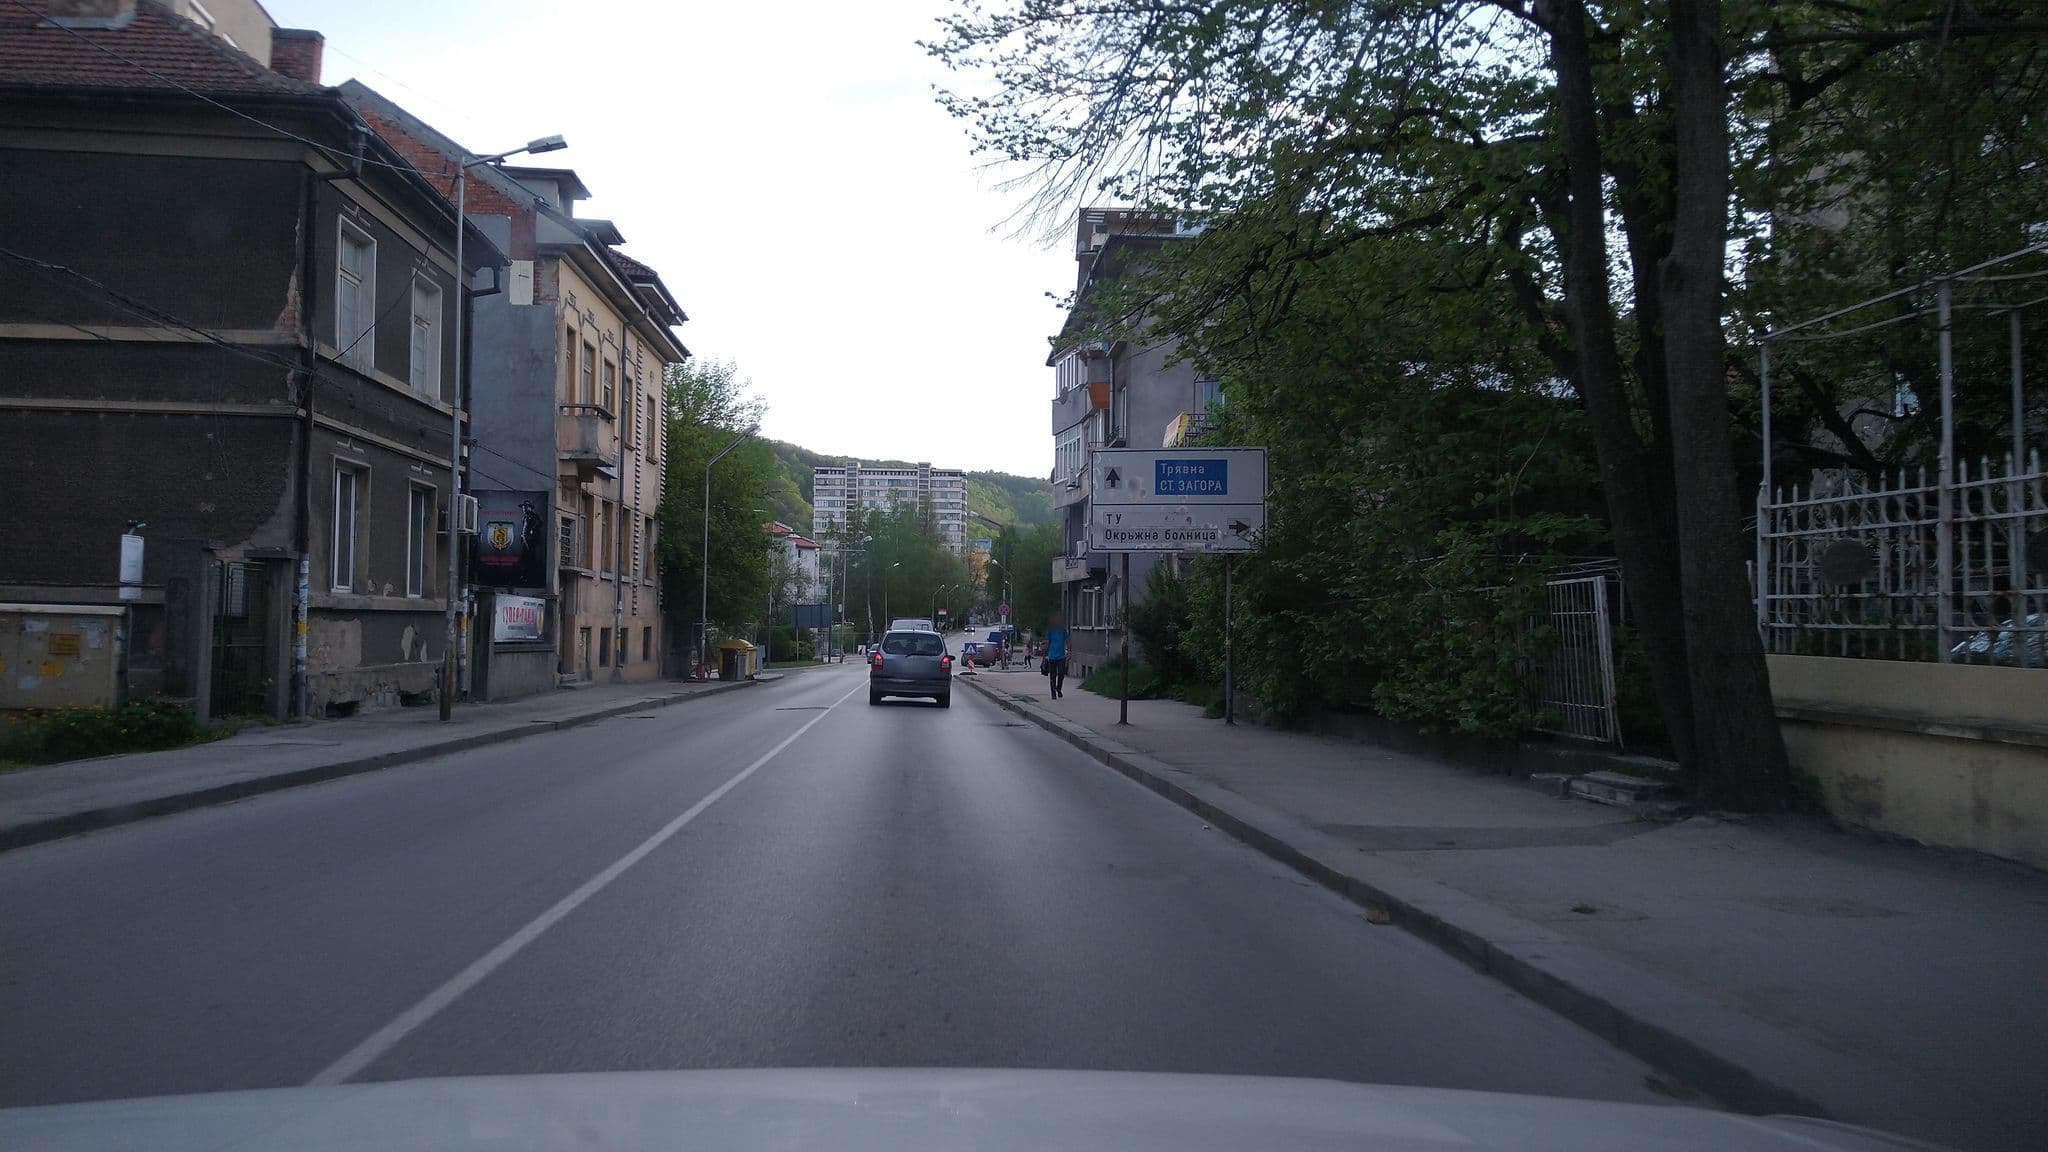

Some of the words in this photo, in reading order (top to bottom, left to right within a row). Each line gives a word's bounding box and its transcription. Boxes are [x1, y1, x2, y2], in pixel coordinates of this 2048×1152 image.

[1160, 463, 1205, 476] Трявна
[1178, 479, 1222, 491] ЗАГОРА
[1106, 513, 1122, 524] ТУ
[1105, 529, 1158, 543] Окръжна
[1164, 529, 1216, 542] болница
